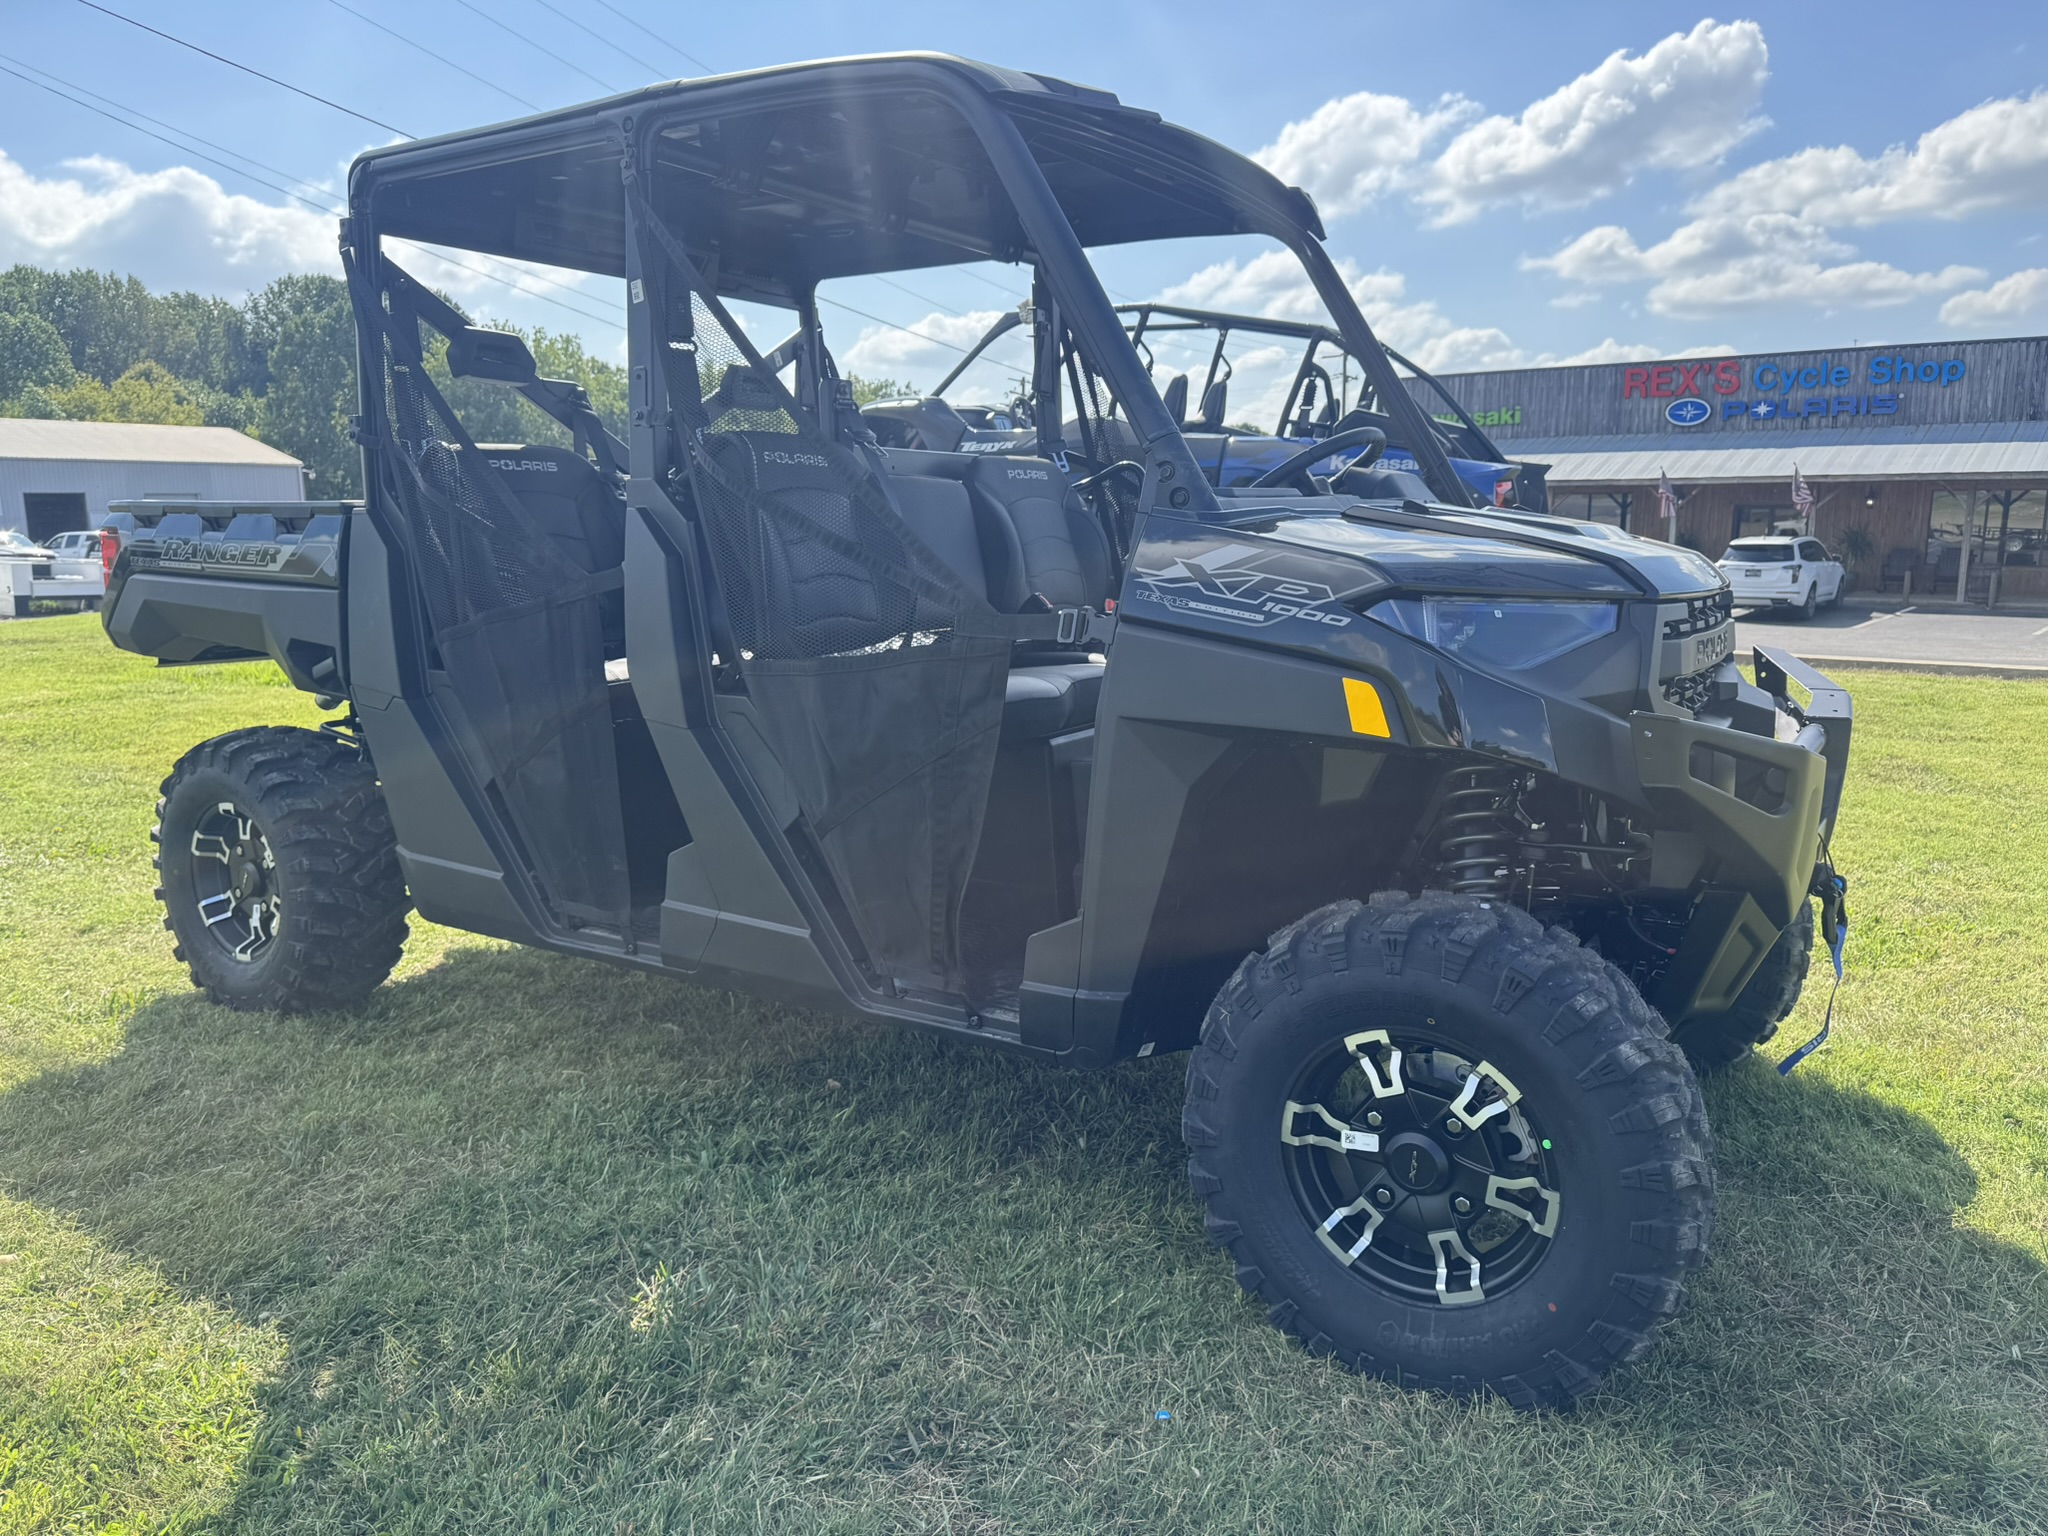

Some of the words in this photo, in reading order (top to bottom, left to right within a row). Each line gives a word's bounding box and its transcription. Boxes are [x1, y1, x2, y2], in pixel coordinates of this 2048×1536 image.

[1623, 360, 1741, 398] REX'S
[1753, 359, 1850, 395] Cycle
[1868, 356, 1965, 387] Shop
[1721, 394, 1899, 422] POLARIS
[487, 459, 559, 472] POLARIS
[763, 451, 829, 467] POLARIS
[1006, 469, 1049, 481] POLARIS
[160, 540, 284, 566] RANGER
[1134, 544, 1336, 605] XP
[1135, 589, 1192, 609] TEXAS
[1261, 601, 1352, 627] 1000
[1800, 1030, 1827, 1055] RIS
